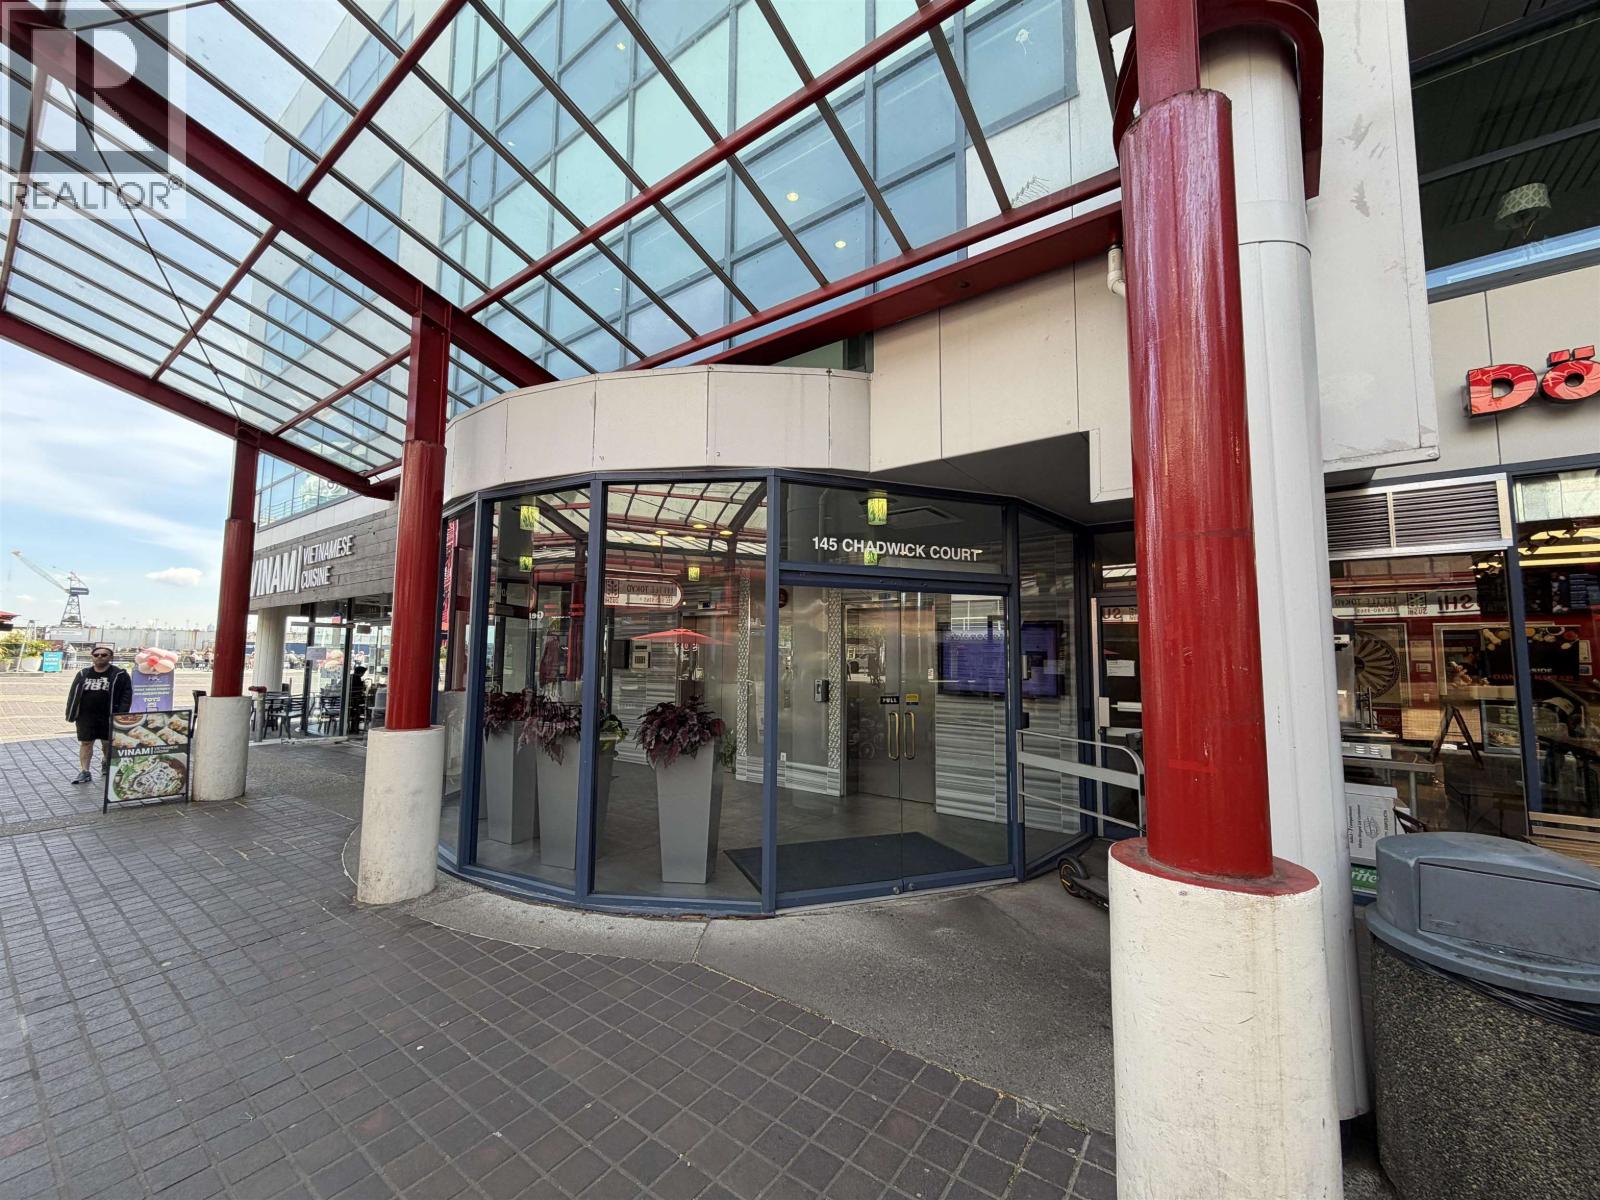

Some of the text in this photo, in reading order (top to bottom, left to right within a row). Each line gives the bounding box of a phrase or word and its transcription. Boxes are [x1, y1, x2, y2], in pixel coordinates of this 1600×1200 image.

[303, 534, 355, 566] VIETNAMESE
[812, 536, 979, 562] 145 CHADWICK COURT
[249, 549, 298, 597] VINAM
[300, 565, 332, 590] CUISINE
[117, 747, 150, 757] VINAM
[1351, 869, 1377, 884] rite
